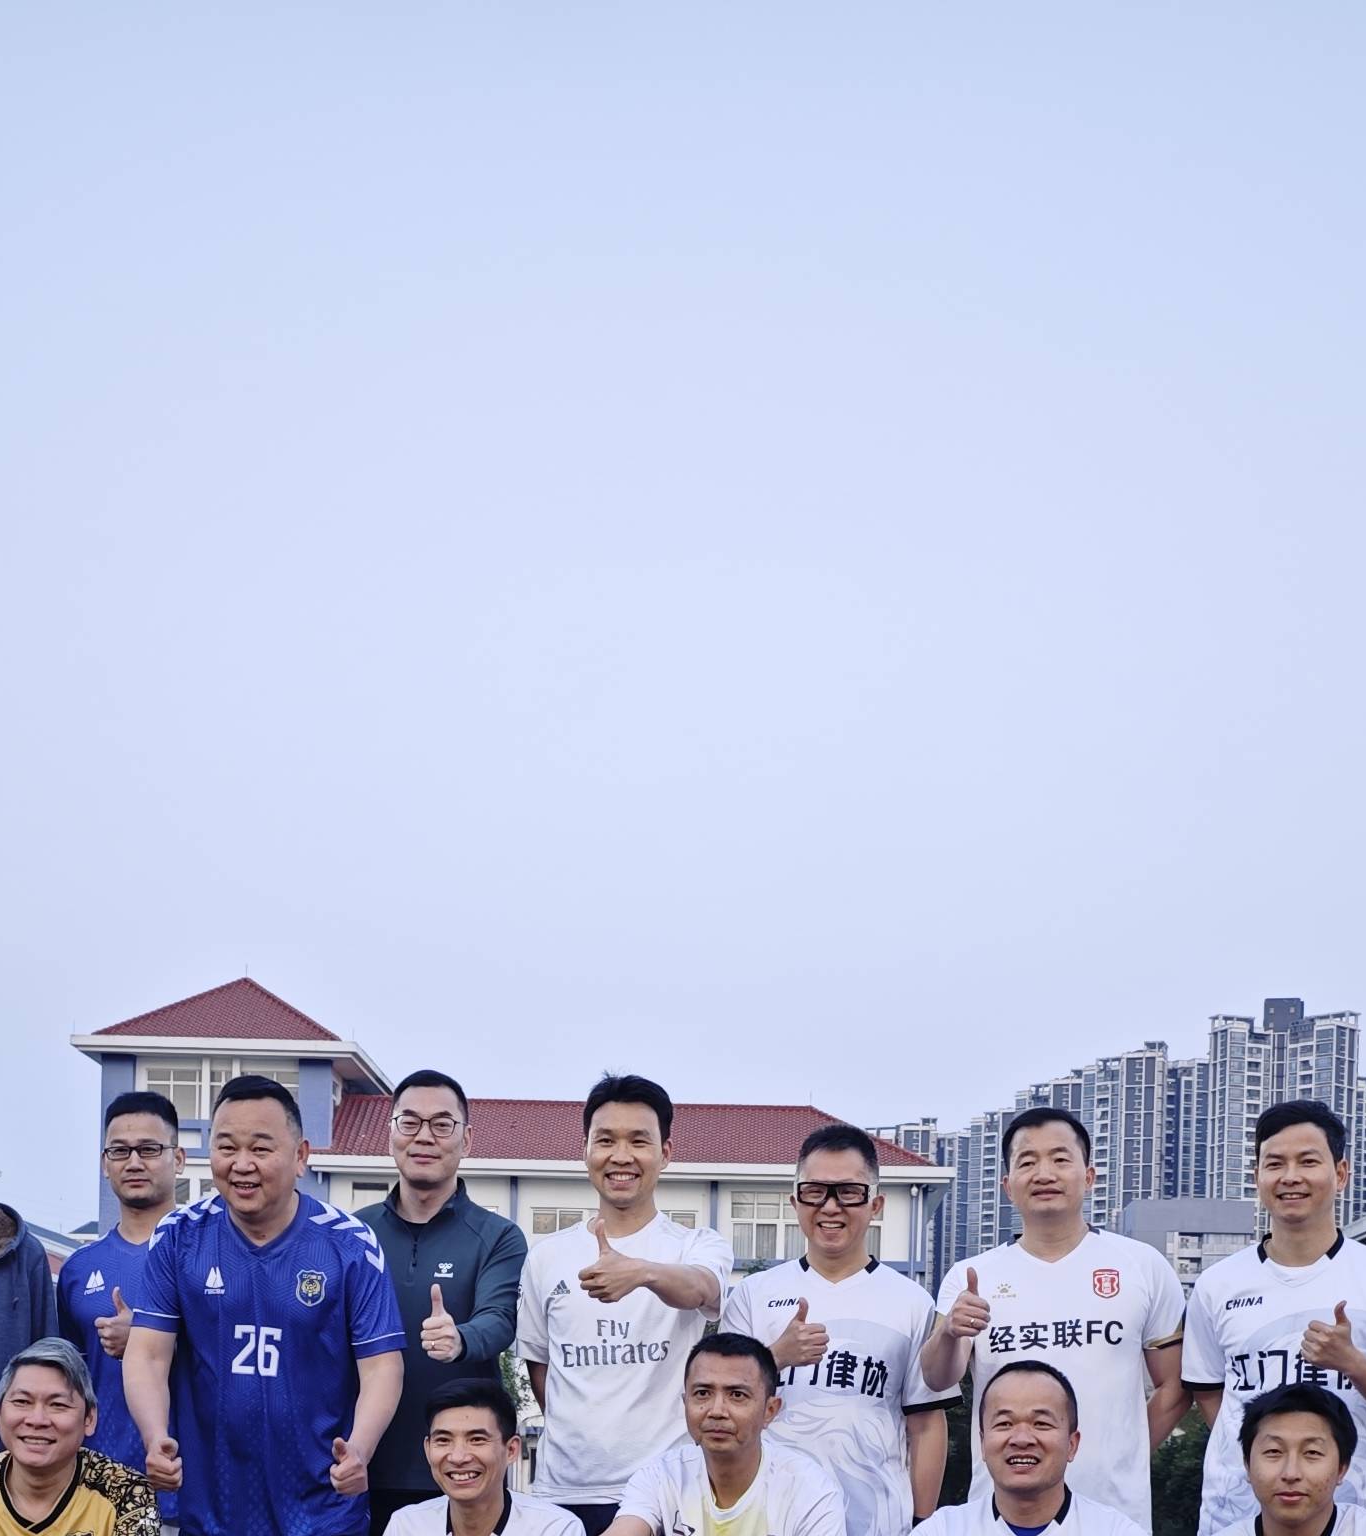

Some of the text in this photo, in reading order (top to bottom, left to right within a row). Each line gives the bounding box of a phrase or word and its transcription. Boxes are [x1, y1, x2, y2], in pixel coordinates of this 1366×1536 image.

[767, 1298, 800, 1308] CHIN
[1225, 1296, 1263, 1311] CHINA
[596, 1319, 630, 1340] Fly
[988, 1318, 1124, 1354] 经实联FC
[231, 1324, 283, 1378] 26
[560, 1339, 671, 1368] Emirates
